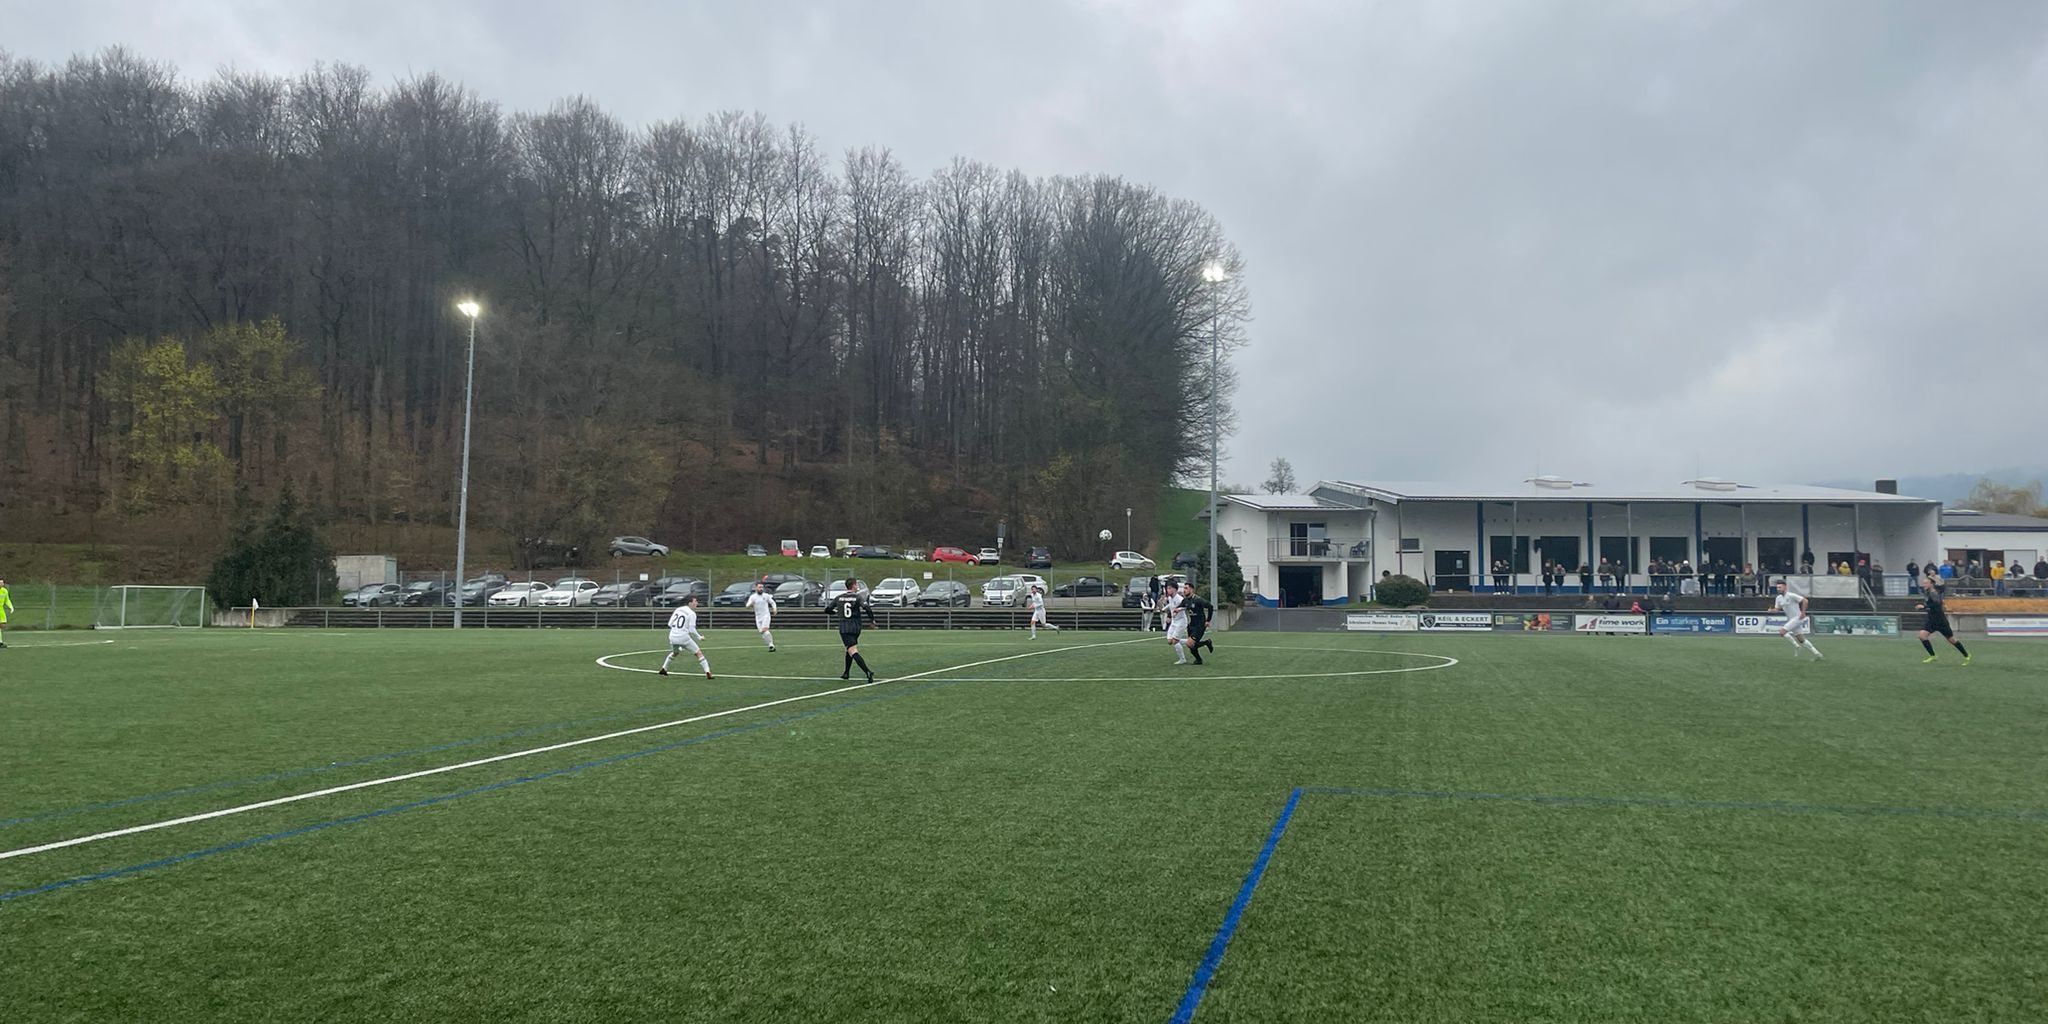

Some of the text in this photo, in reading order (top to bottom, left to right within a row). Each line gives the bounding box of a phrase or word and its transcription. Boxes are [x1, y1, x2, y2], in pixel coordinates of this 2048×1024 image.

[844, 602, 852, 618] 6
[671, 613, 686, 629] 20
[1622, 618, 1645, 626] work
[1656, 617, 1726, 625] Ein starkes Team!
[1737, 617, 1759, 626] GED
